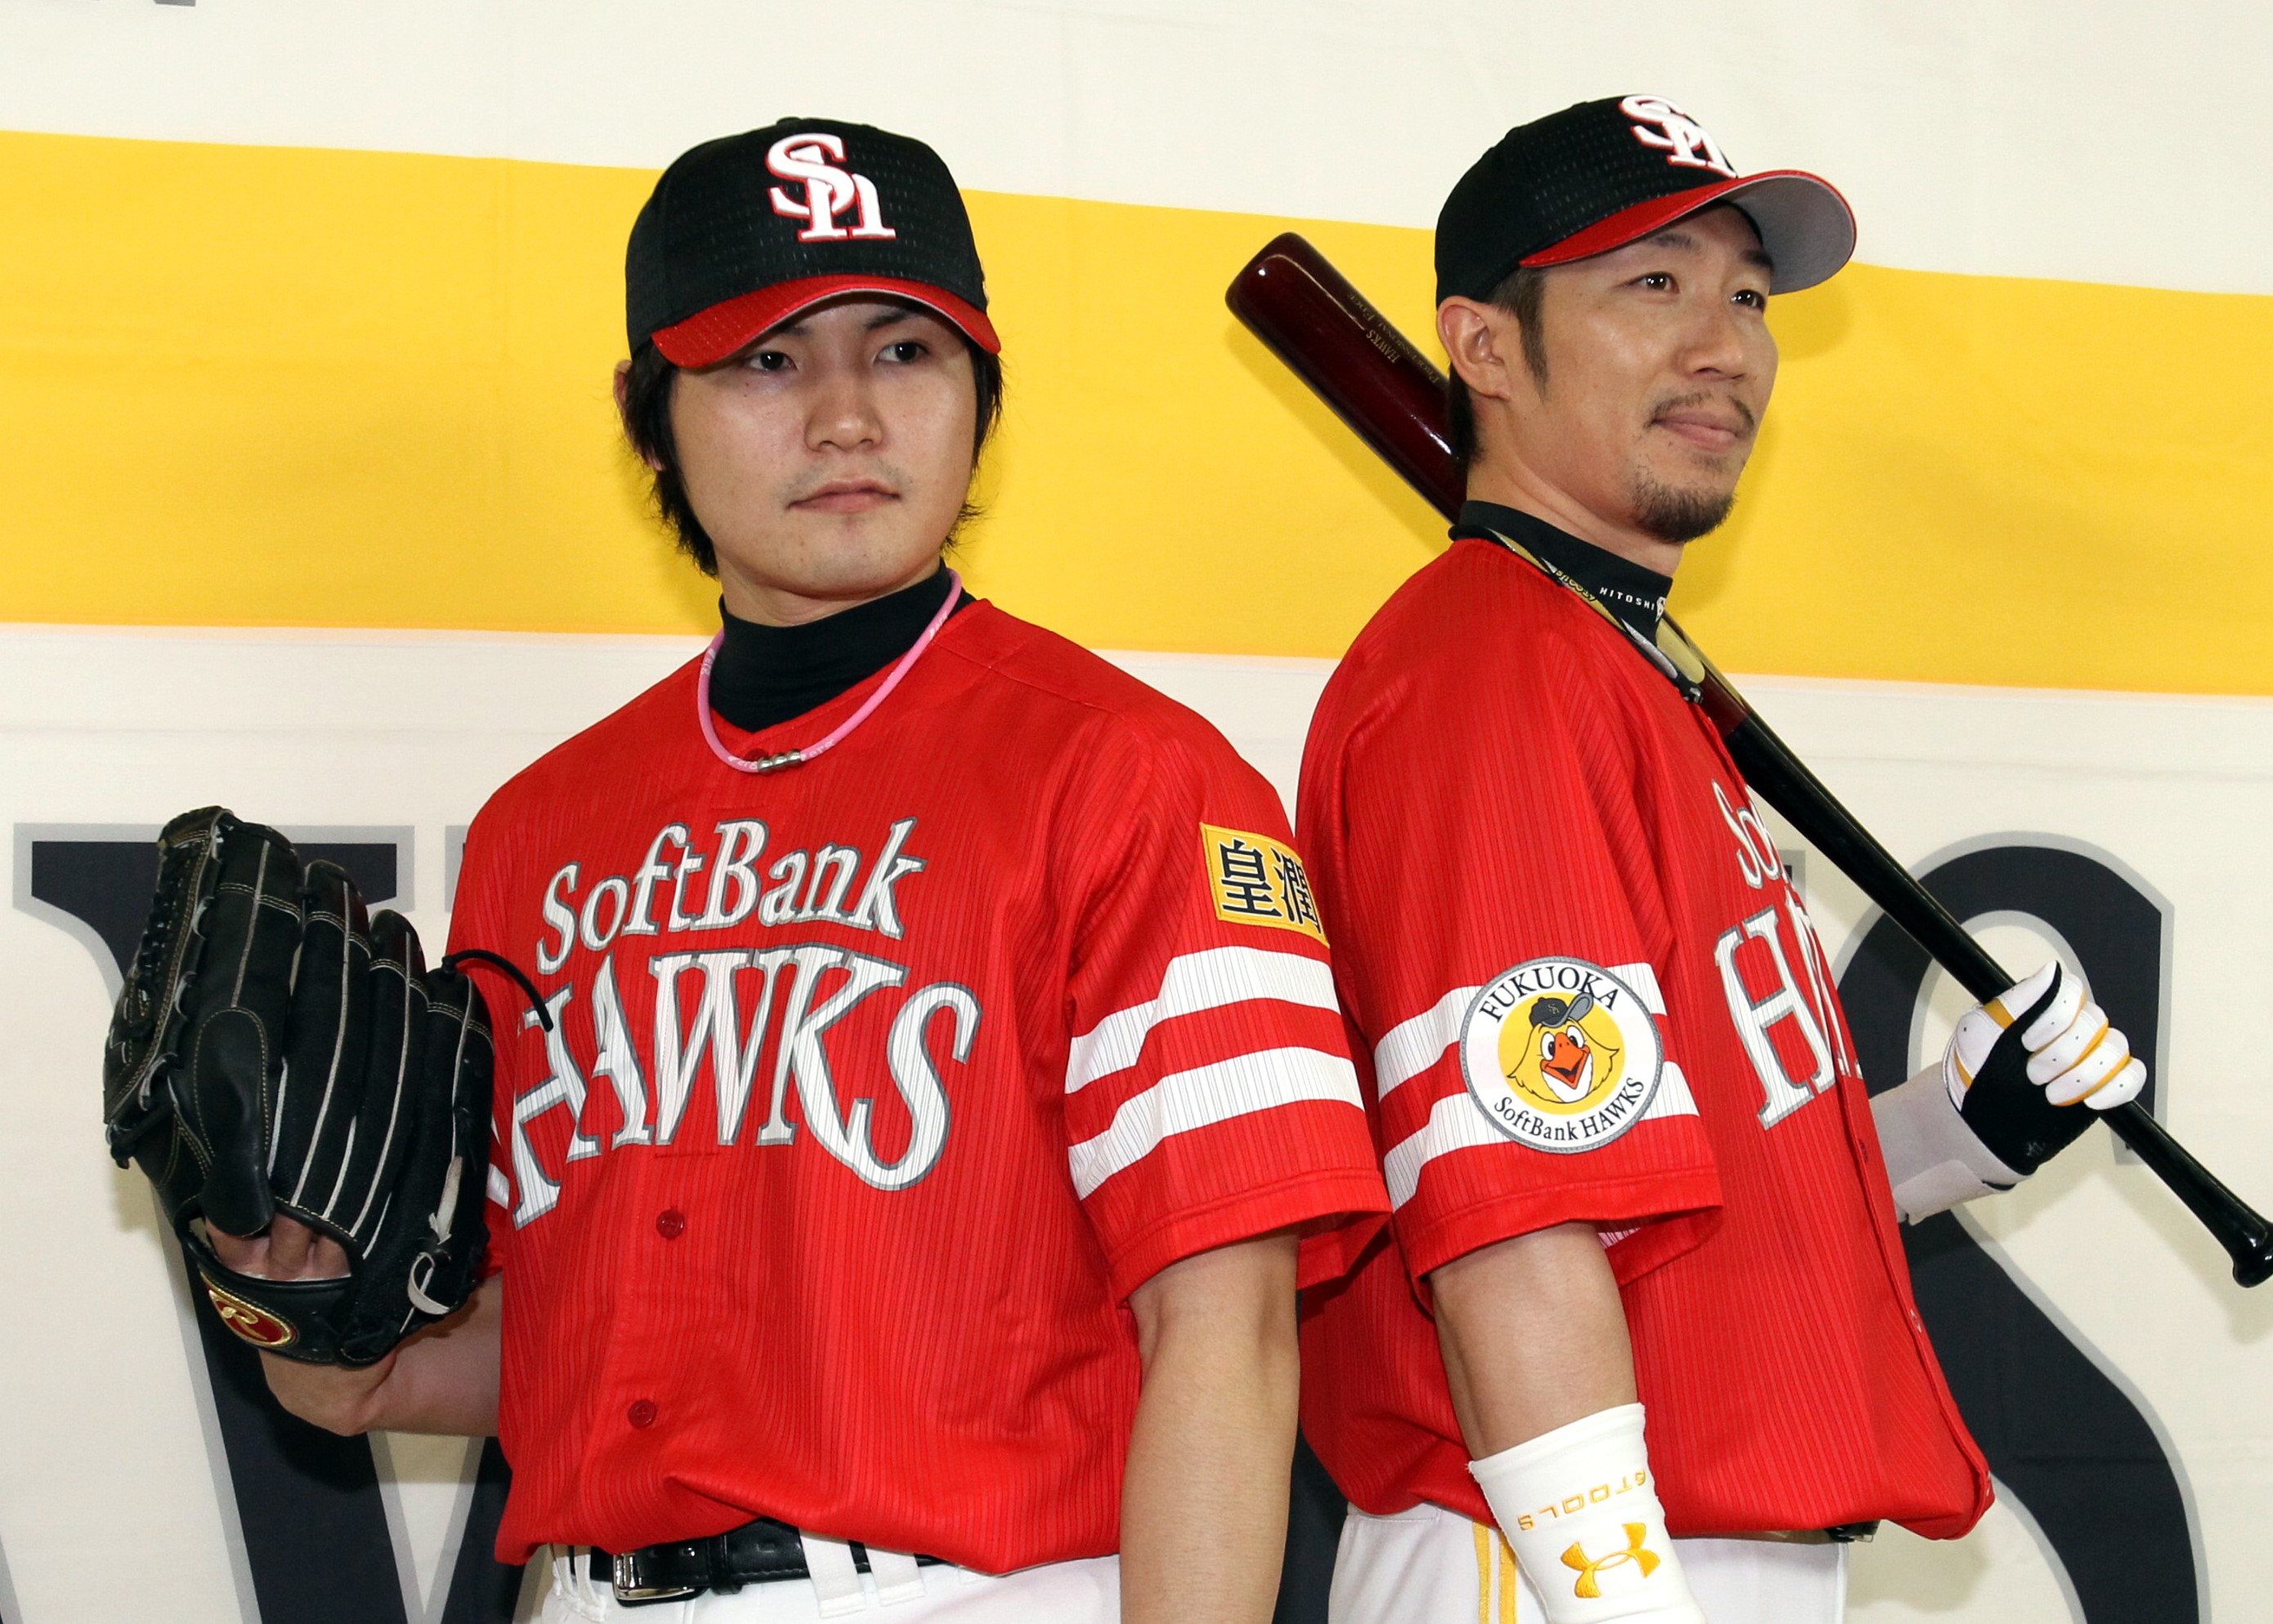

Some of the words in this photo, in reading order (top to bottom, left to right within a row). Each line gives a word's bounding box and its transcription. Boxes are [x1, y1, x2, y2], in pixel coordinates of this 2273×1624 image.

[1366, 329, 1400, 363] HAWKS
[1600, 586, 1655, 611] HITOSHI
[536, 816, 927, 976] SoftBank
[1219, 838, 1322, 934] 皇潤
[1479, 965, 1620, 1023] FUKUOKA
[512, 942, 983, 1231] HAWKS
[1493, 1096, 1578, 1142] SoftBank
[1578, 1076, 1645, 1139] HAWKS
